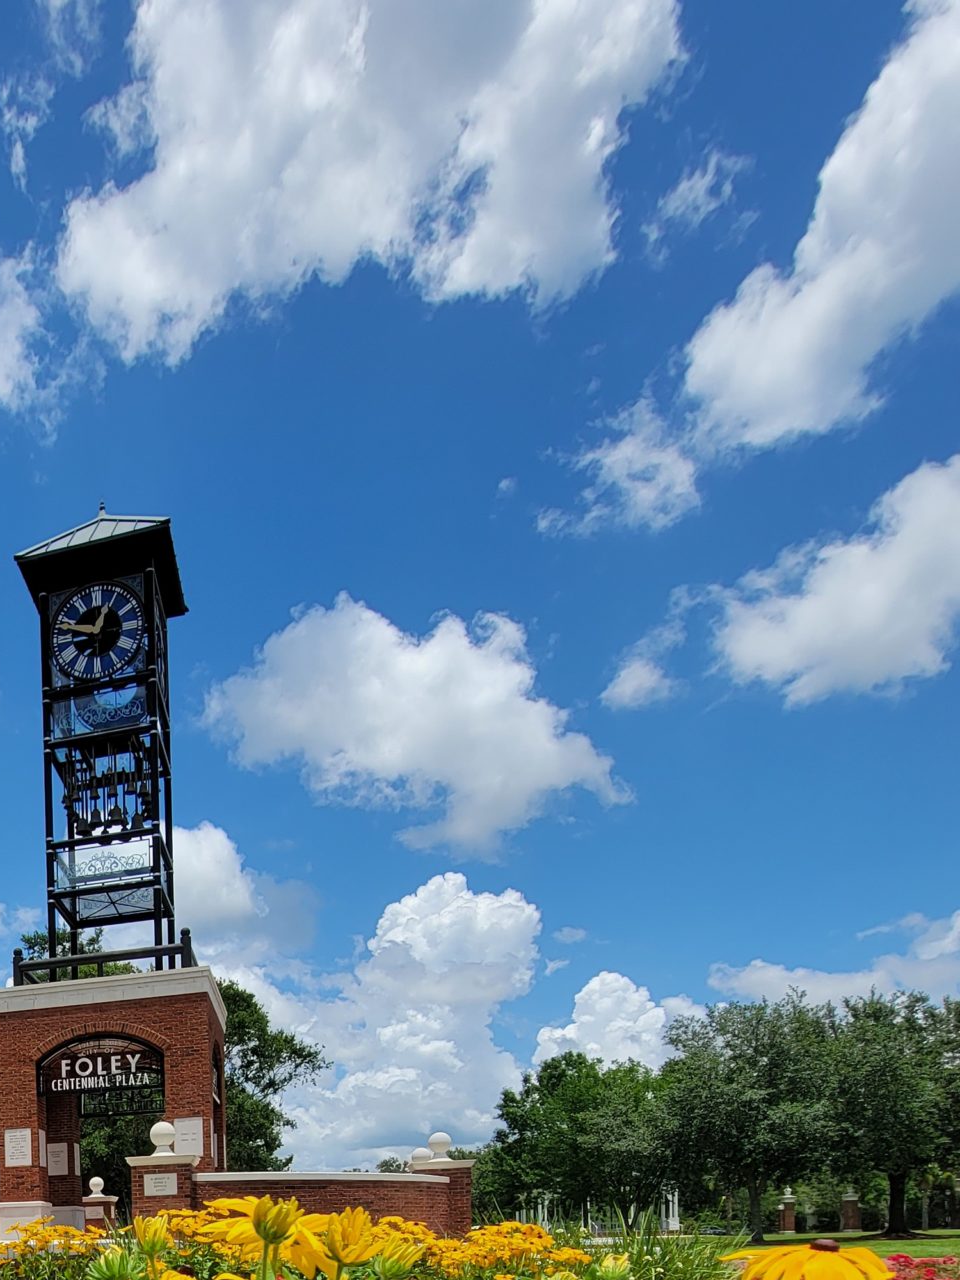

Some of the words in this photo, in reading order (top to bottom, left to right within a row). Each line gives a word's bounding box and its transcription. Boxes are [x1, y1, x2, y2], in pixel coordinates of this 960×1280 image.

[91, 591, 102, 608] XII
[81, 1048, 97, 1056] CITY
[61, 1054, 141, 1078] FOLEY
[51, 1075, 110, 1091] CENTENNIAL
[116, 1072, 150, 1086] PLAZA
